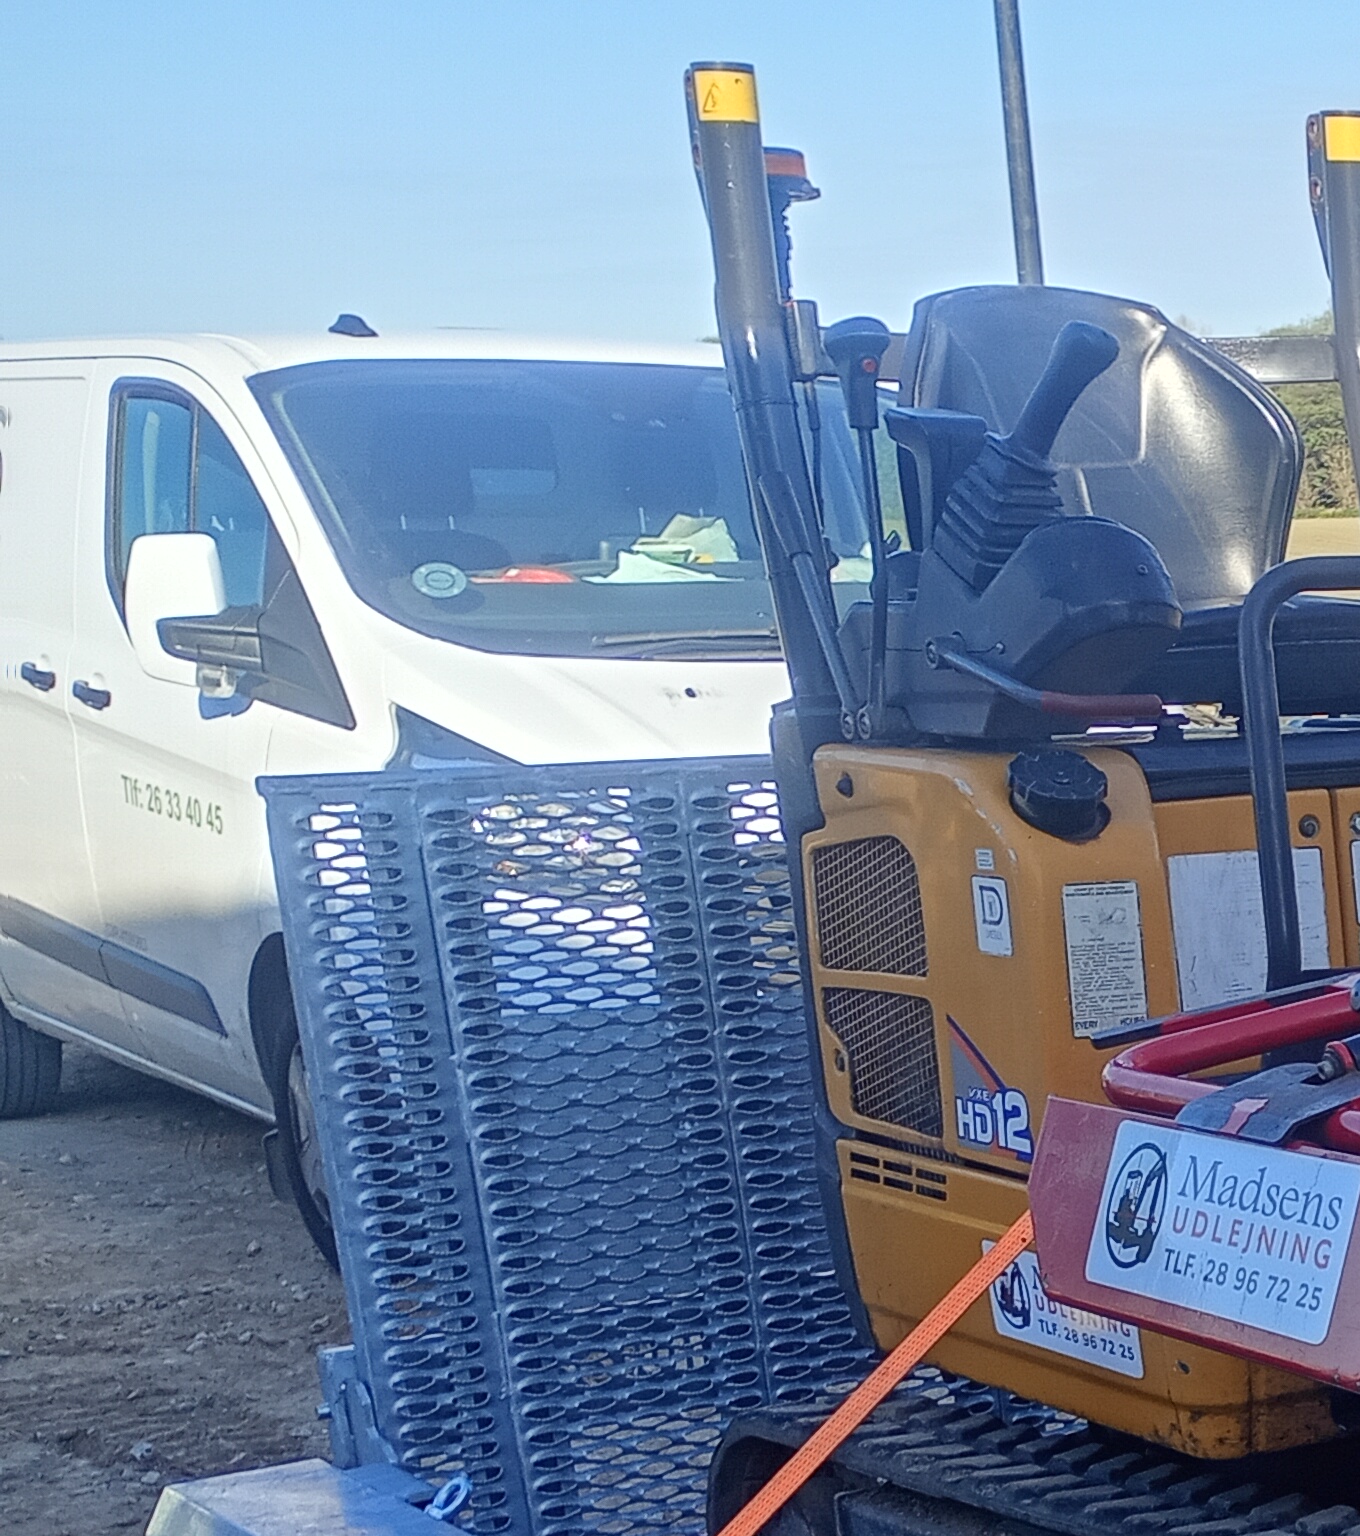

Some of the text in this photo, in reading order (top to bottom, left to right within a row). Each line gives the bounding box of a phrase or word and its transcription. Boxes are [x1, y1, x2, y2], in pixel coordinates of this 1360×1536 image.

[121, 774, 223, 835] Tlf: 26 33 40 45
[1177, 1154, 1343, 1232] Madsens
[1171, 1204, 1333, 1270] UDLEJNING
[1163, 1247, 1324, 1313] TLF. 28 96 72 25
[1038, 1319, 1135, 1361] TLF. 28 96 72 25
